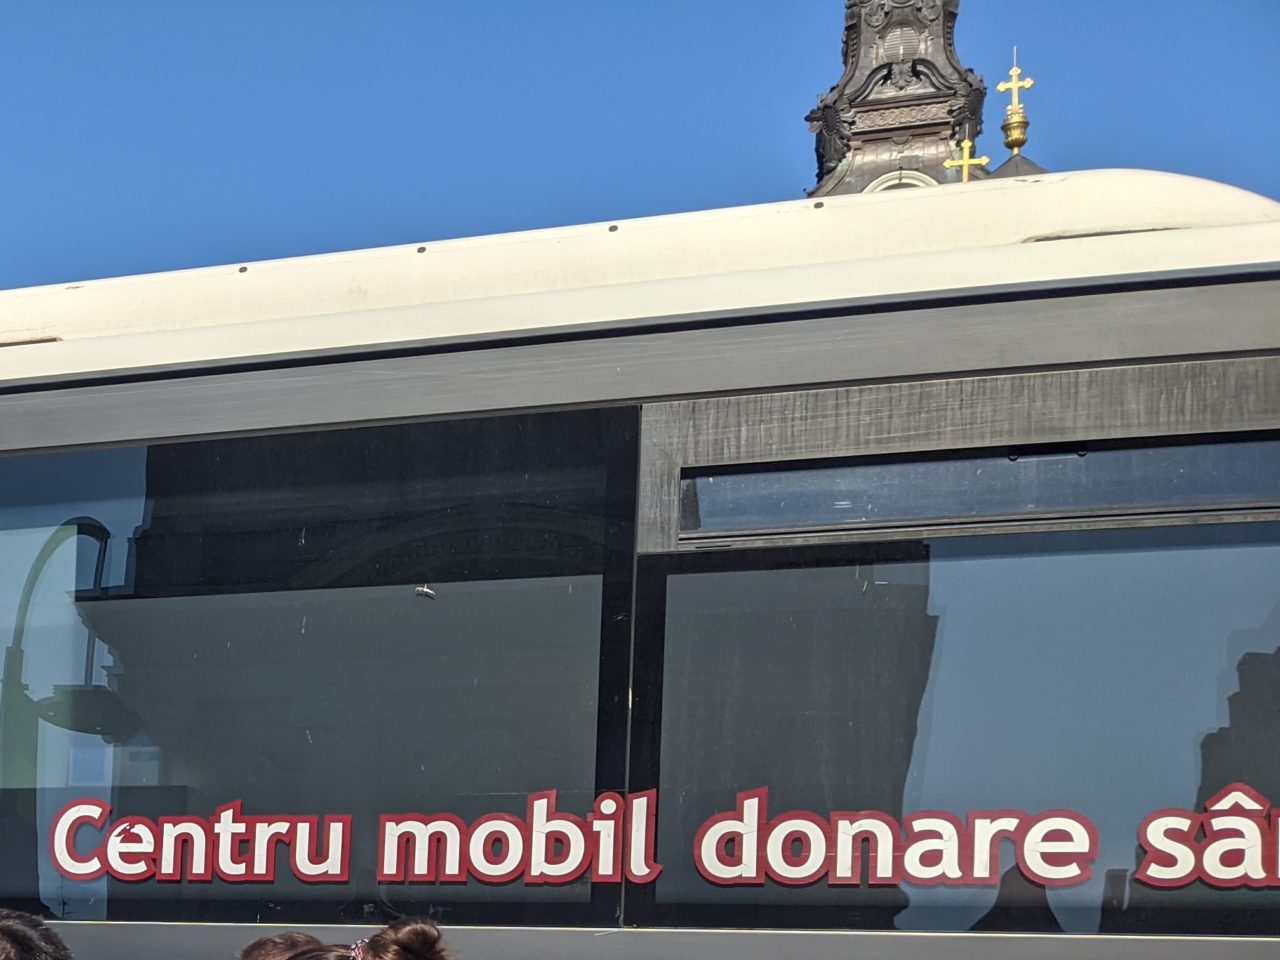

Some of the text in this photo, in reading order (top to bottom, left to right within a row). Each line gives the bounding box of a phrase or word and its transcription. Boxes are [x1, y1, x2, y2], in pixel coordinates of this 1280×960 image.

[51, 787, 1280, 884] Centru mobil donare sâ
